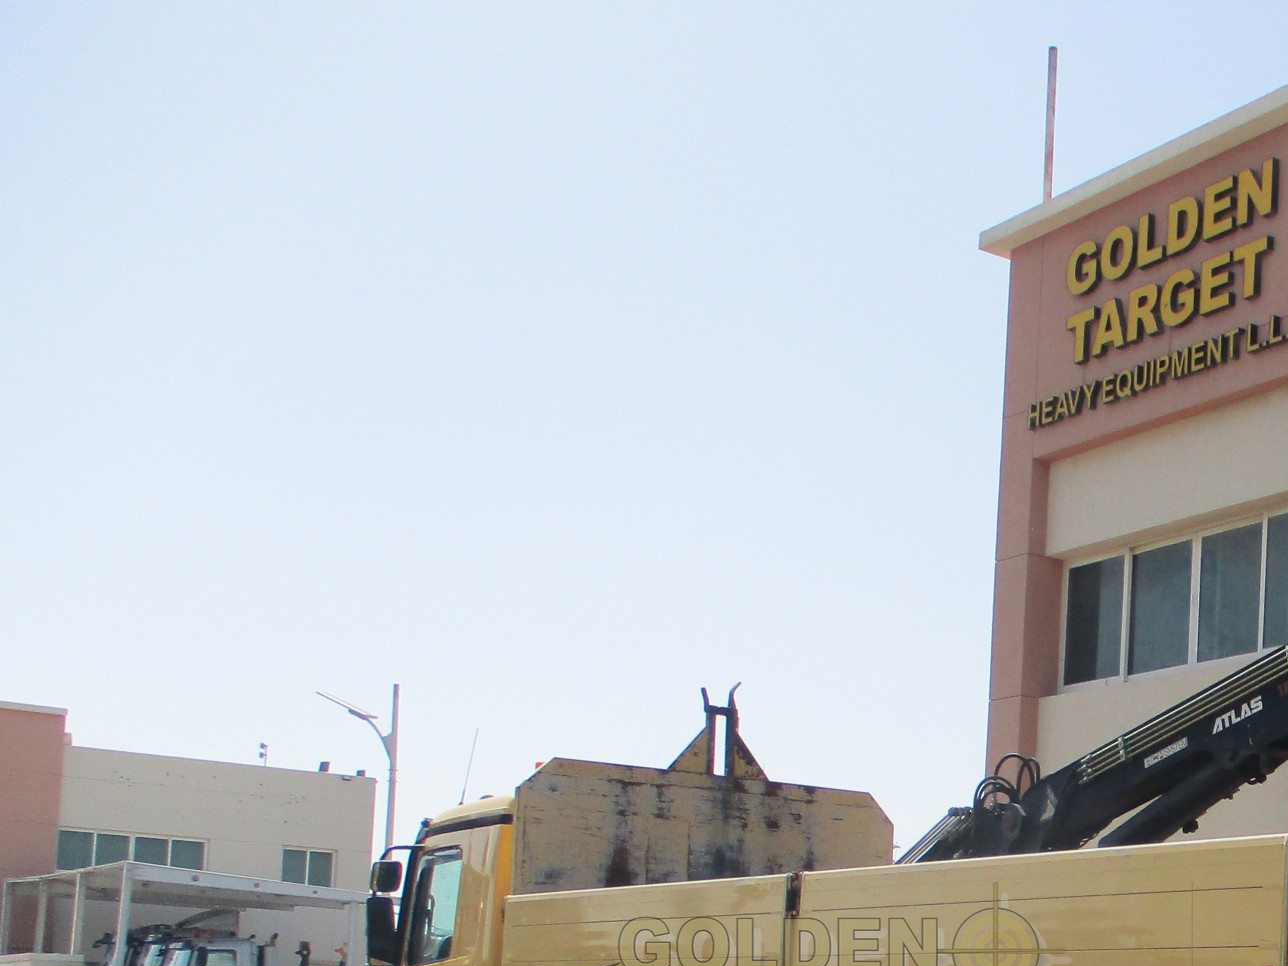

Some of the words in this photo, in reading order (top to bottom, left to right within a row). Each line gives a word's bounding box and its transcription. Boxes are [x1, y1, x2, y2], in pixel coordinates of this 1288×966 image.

[1066, 158, 1277, 296] GOLDEN
[1066, 236, 1271, 364] TARGET
[1027, 382, 1101, 431] HEAVY
[1102, 327, 1243, 404] EQUIPMENT
[1212, 696, 1264, 735] ATLAS
